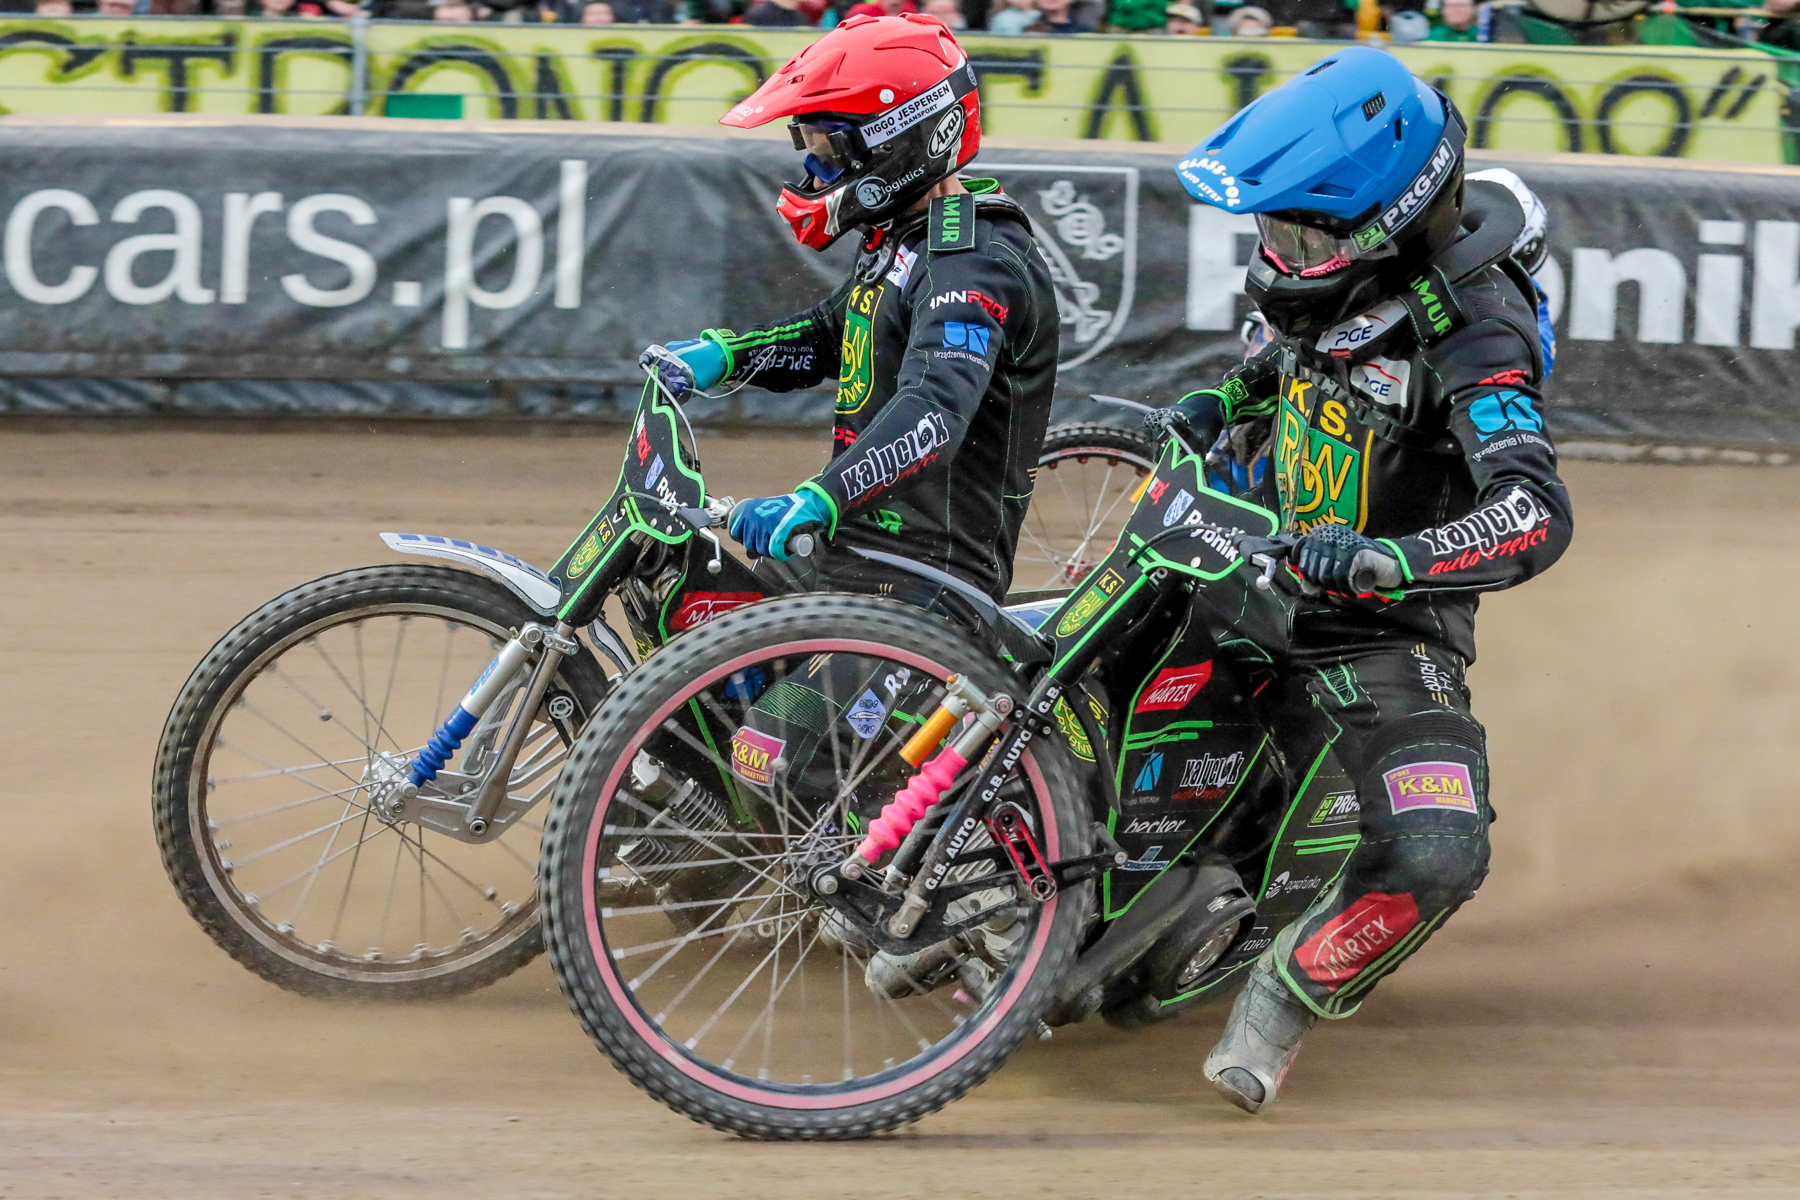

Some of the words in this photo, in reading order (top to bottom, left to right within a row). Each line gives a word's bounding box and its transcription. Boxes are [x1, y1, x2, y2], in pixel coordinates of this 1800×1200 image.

[863, 116, 896, 138] VIGGO
[898, 84, 950, 121] JESPERSEN
[885, 127, 900, 137] INT.
[900, 103, 938, 129] TRANSPORT
[932, 108, 960, 156] Arai
[880, 166, 925, 195] logistics
[1181, 170, 1200, 184] AUTO
[1382, 145, 1450, 228] PRG-M
[4, 160, 587, 349] cars.pl
[1335, 325, 1374, 346] PGE
[1428, 548, 1482, 575] auto
[1037, 686, 1063, 714] G.B.
[1143, 683, 1197, 705] MARTEX
[732, 739, 770, 771] K&M
[981, 772, 1008, 802] G.B.
[1002, 730, 1034, 771] AUTO
[1389, 768, 1411, 781] SPORT
[1397, 776, 1465, 797] K&M
[1435, 796, 1472, 808] MARKETING
[1124, 815, 1187, 833] becker
[924, 862, 951, 890] G.B.
[946, 817, 977, 860] AUTO
[1320, 914, 1395, 979] MARTEX
